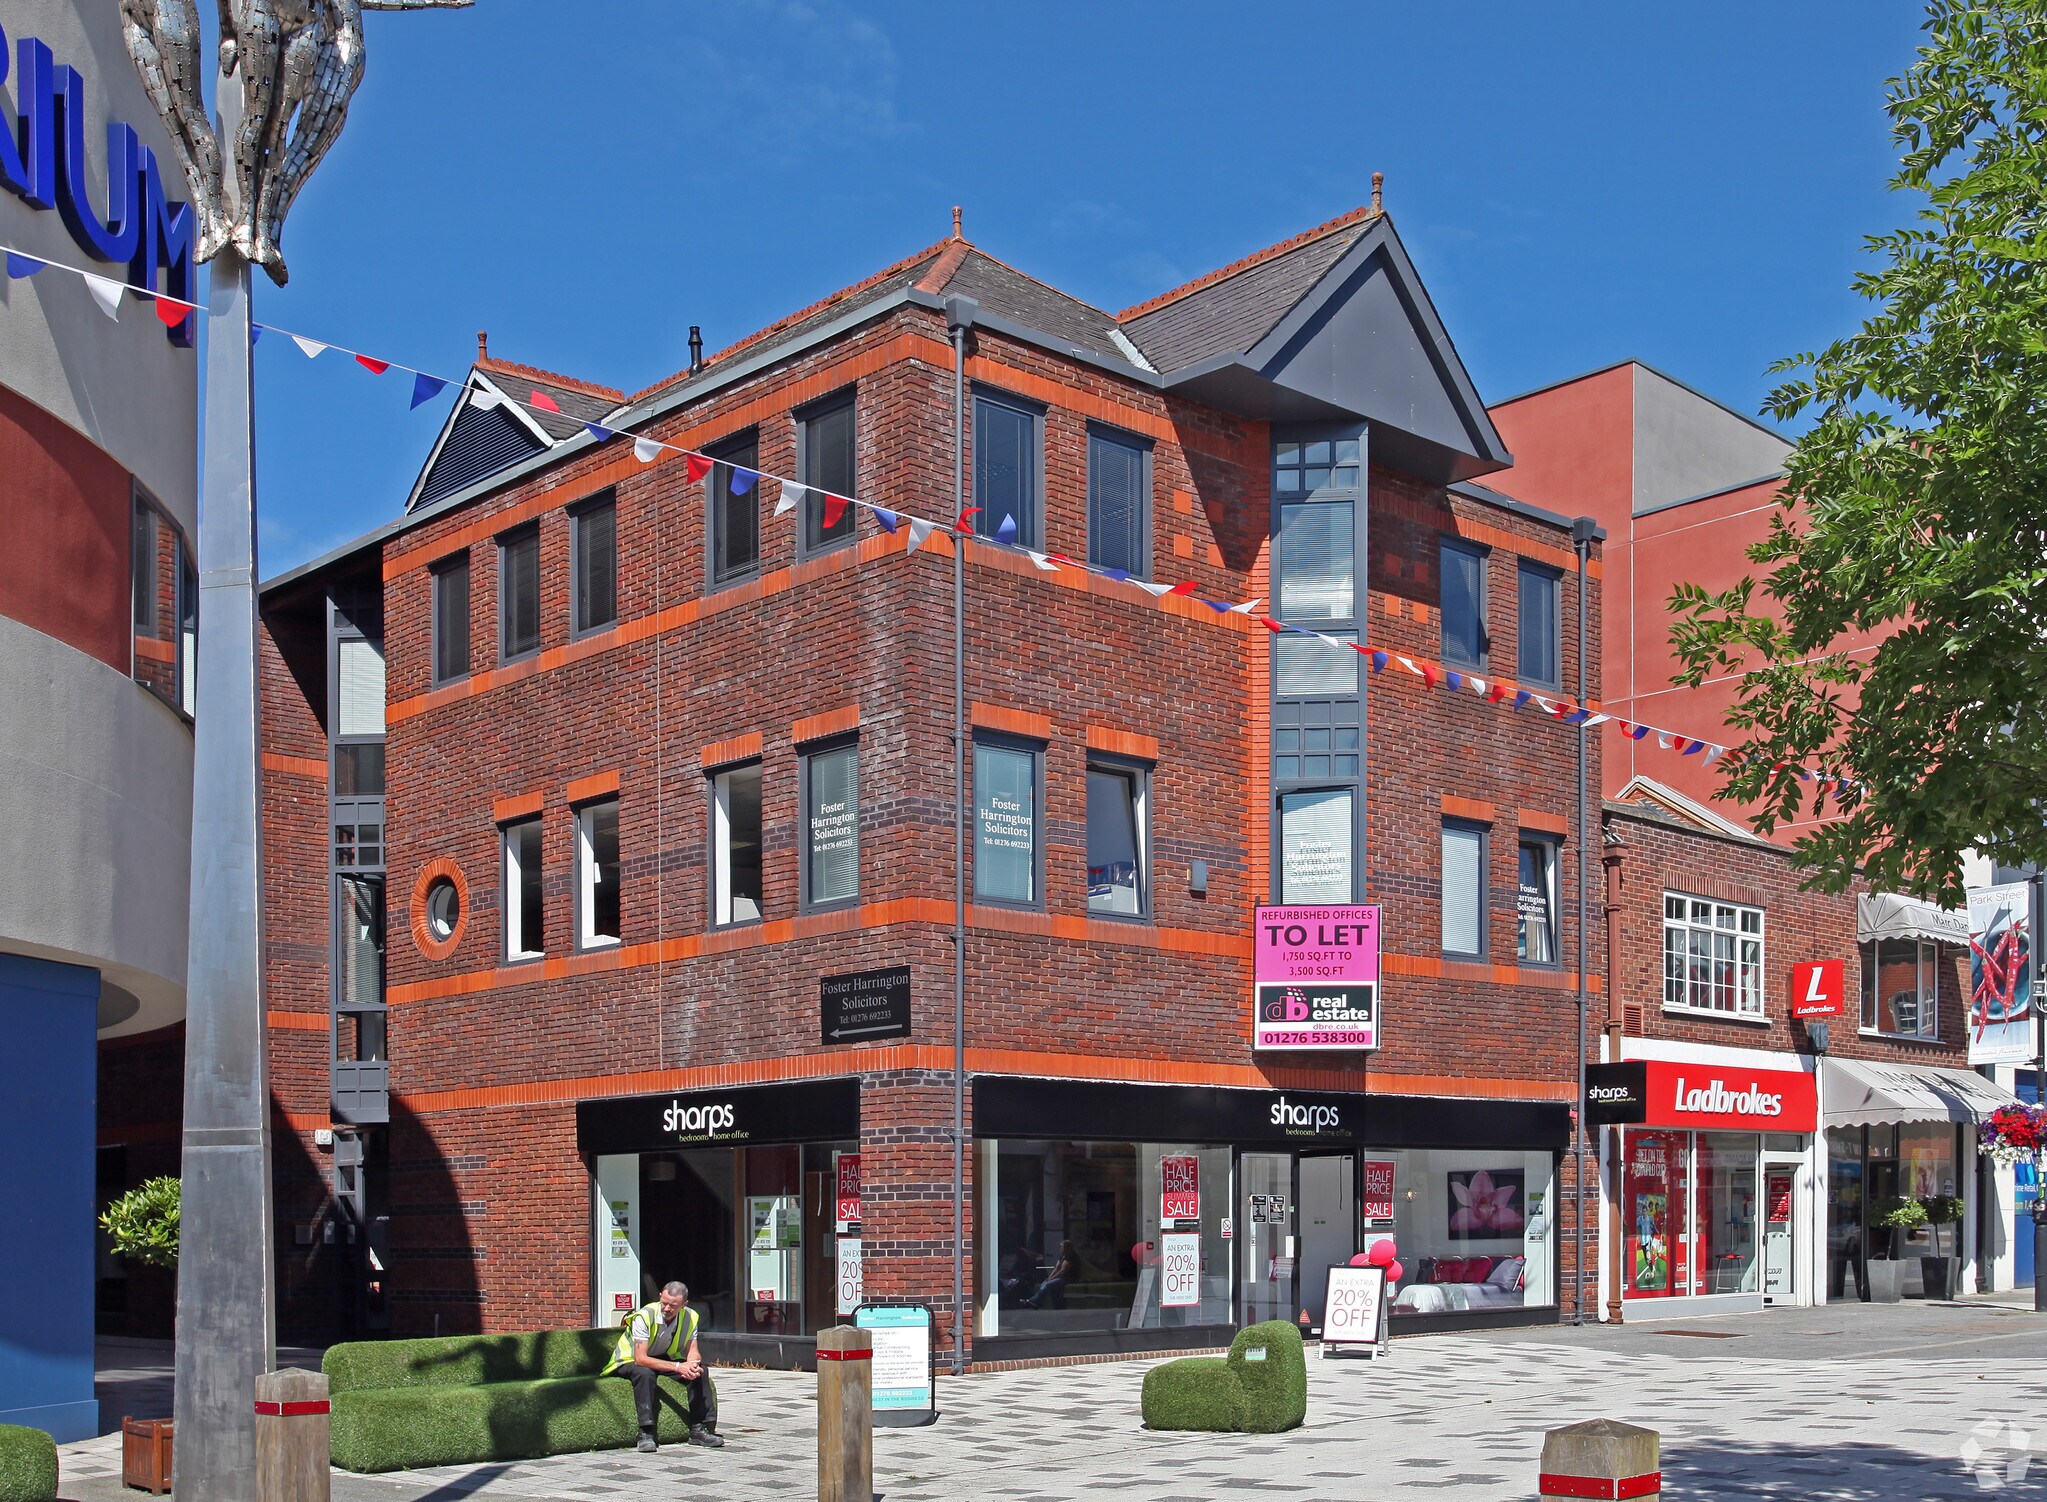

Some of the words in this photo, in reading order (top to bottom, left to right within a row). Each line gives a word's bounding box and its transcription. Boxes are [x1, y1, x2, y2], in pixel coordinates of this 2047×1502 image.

[821, 803, 845, 814] Foster
[992, 798, 1020, 811] Foster
[811, 813, 854, 828] Harrington
[981, 809, 1031, 825] Harrington
[815, 826, 851, 840] Solicitors
[985, 822, 1028, 836] Solicitors
[1520, 884, 1538, 893] Foster
[1518, 894, 1546, 905] arrington
[1970, 895, 1992, 905] Park
[1996, 890, 2026, 901] Street
[1517, 902, 1544, 913] Solicitors
[1262, 911, 1330, 920] REFURBISHED
[1333, 911, 1372, 919] OFFICES
[1931, 913, 1951, 928] Marc
[1953, 918, 1969, 931] Dan
[1265, 925, 1307, 946] TO
[1318, 925, 1369, 946] LET
[1282, 952, 1304, 961] 1,750
[1307, 952, 1335, 962] SQ.FT
[1338, 952, 1352, 960] TO
[1289, 967, 1313, 976] 3,500
[1316, 966, 1344, 976] SQ.FT
[822, 982, 851, 995] Foster
[854, 974, 909, 990] Harrington
[1806, 966, 1827, 1001] L
[842, 995, 888, 1010] Solicitors
[1312, 994, 1347, 1008] real
[869, 1010, 892, 1021] 692233
[1312, 1008, 1369, 1020] estate
[1797, 1005, 1835, 1014] Ladbrokes
[1312, 1023, 1359, 1031] dbre.co.uk
[1264, 1033, 1307, 1044] 01276
[1312, 1032, 1365, 1043] 538300
[1589, 1085, 1628, 1101] sharps
[1675, 1078, 1782, 1116] Ladbrokes
[663, 1099, 734, 1138] sharps
[1270, 1096, 1339, 1133] sharps
[679, 1133, 710, 1142] bedrooms
[713, 1131, 730, 1140] home
[731, 1130, 749, 1138] office
[1286, 1128, 1315, 1136] bedrooms
[841, 1164, 861, 1179] HAL
[1166, 1165, 1194, 1179] HALF
[1366, 1170, 1391, 1182] HALF
[841, 1180, 861, 1193] PRIC
[1166, 1180, 1195, 1192] PRICE
[1366, 1183, 1390, 1194] PRICE
[841, 1203, 862, 1218] SAL
[1167, 1201, 1195, 1216] SALE
[1366, 1202, 1389, 1216] SALE
[1167, 1255, 1195, 1271] 20%
[1167, 1274, 1195, 1292] OFF
[842, 1282, 862, 1301] OF
[1333, 1289, 1372, 1306] 20%
[1332, 1308, 1371, 1327] OFF
